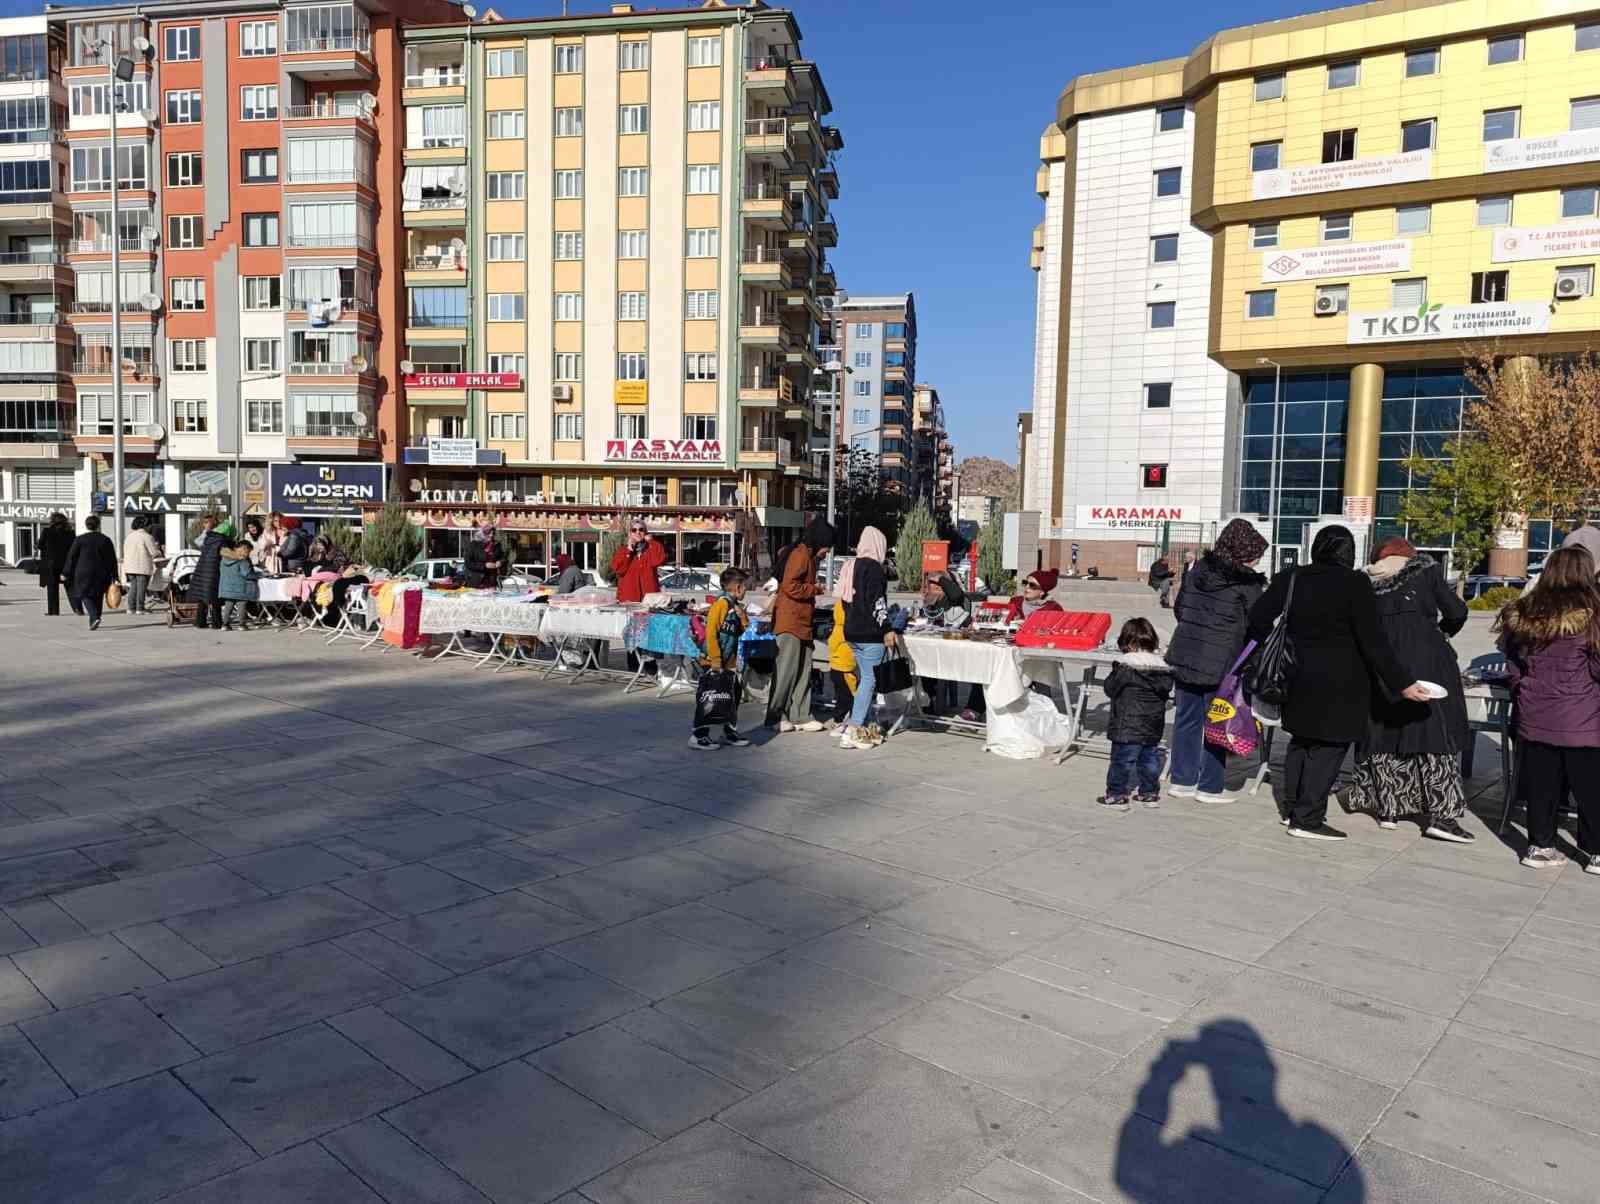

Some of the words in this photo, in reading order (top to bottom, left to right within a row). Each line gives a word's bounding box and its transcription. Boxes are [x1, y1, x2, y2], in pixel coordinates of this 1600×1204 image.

[1362, 313, 1441, 337] TKDK
[466, 376, 502, 386] EMLAK
[631, 439, 721, 452] ASYAM
[283, 483, 374, 498] MODERN
[1092, 507, 1182, 519] KARAMAN
